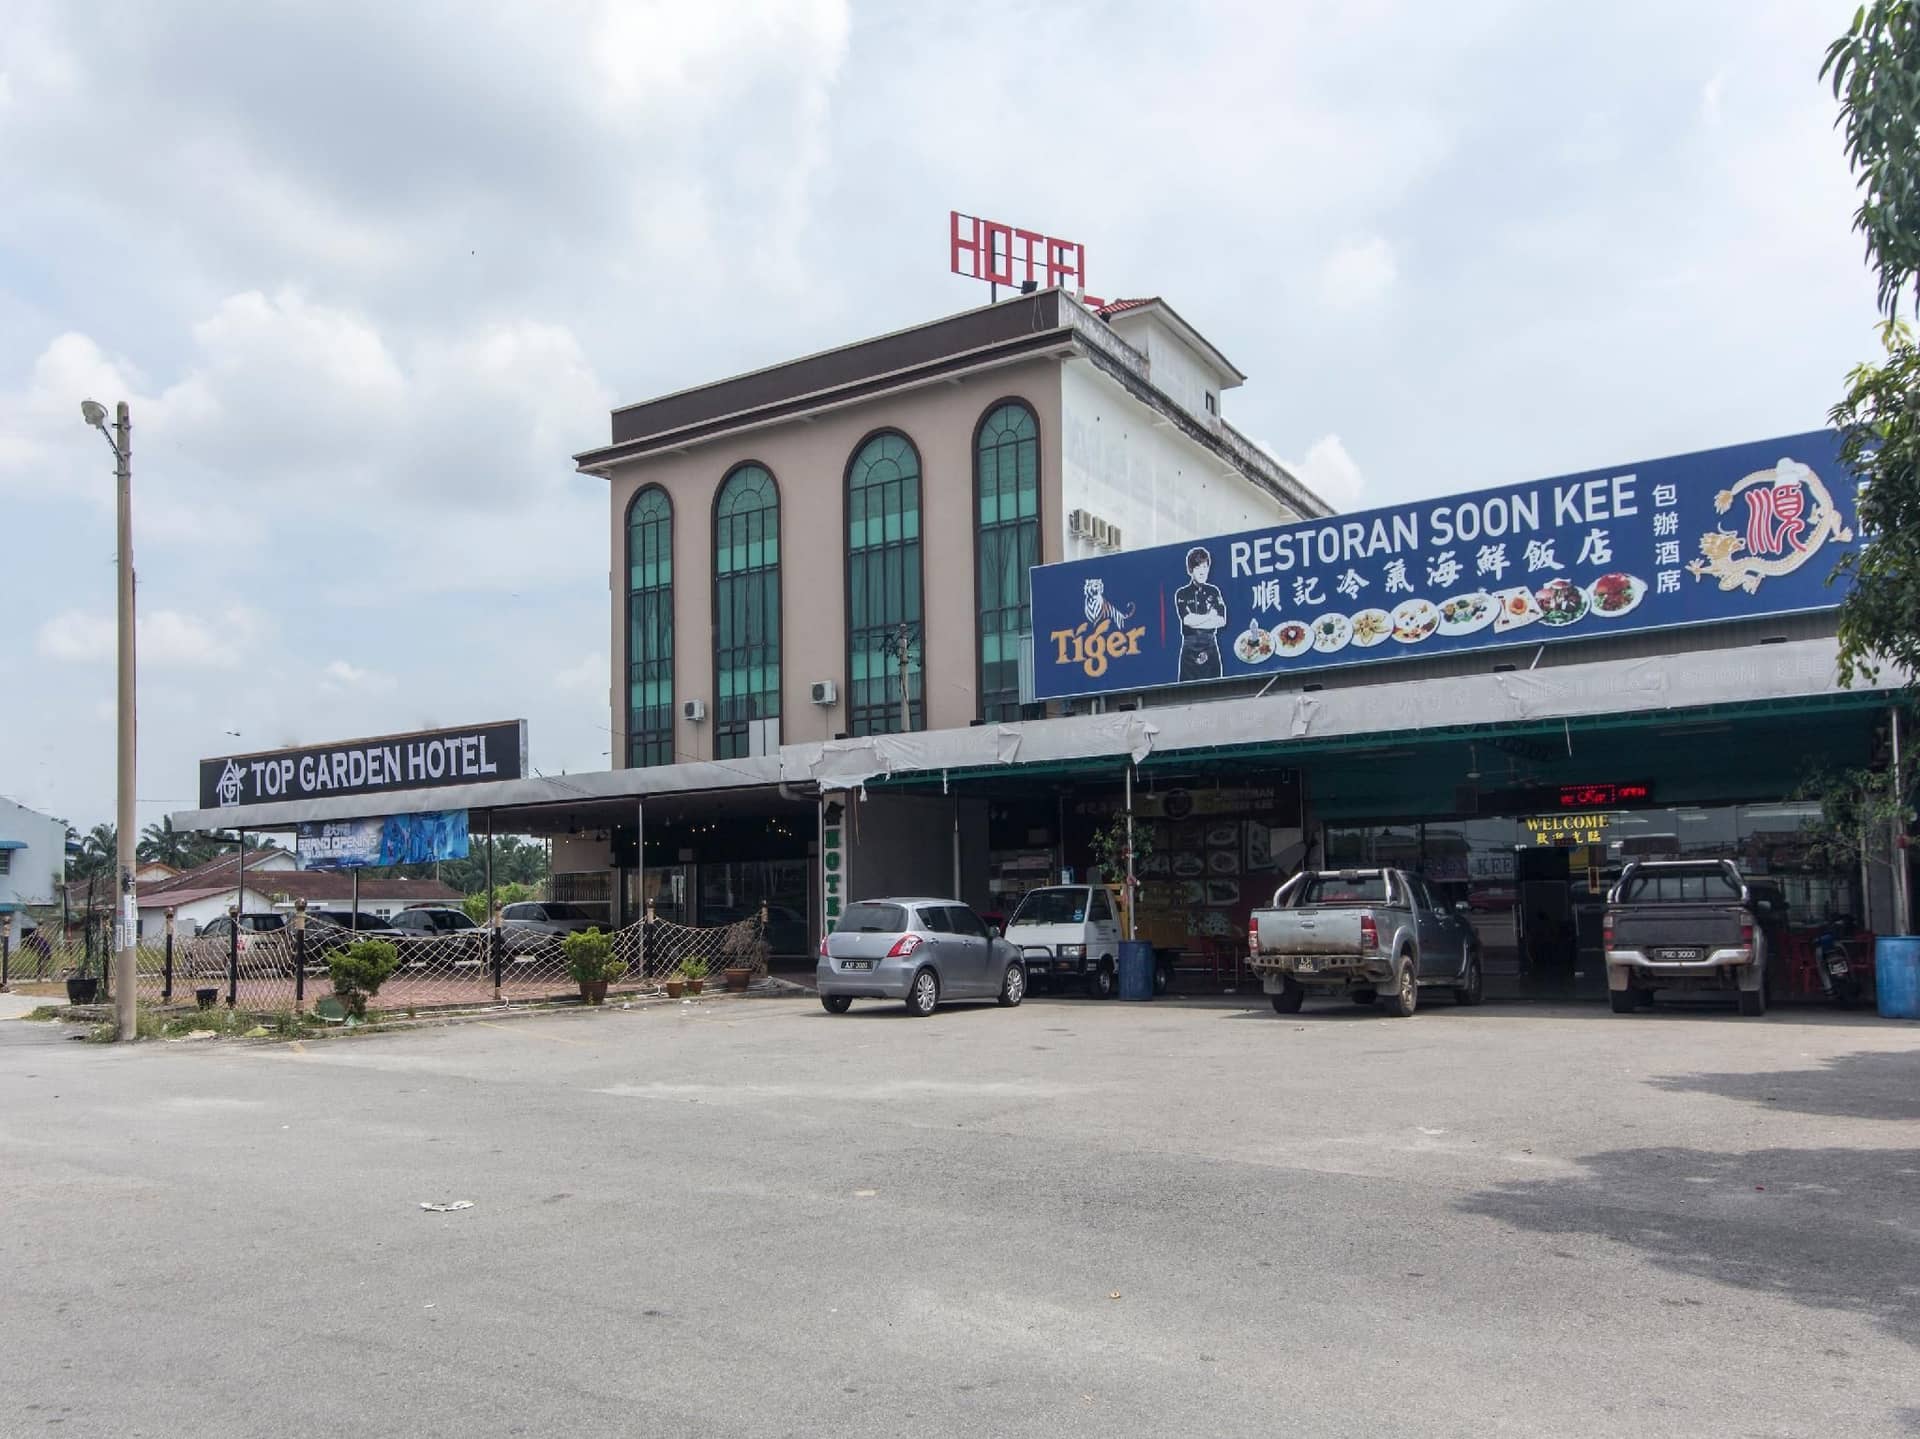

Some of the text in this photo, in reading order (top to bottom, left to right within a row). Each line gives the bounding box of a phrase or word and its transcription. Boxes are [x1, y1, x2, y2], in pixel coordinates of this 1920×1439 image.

[950, 210, 1105, 307] HOTEL
[1230, 473, 1639, 579] RESTORAN SOON KEE
[1651, 483, 1681, 594] 包辦酒席
[1050, 618, 1147, 679] Tiger
[250, 734, 497, 797] TOP GARDEN HOTEL
[297, 831, 378, 851] GRAND OPENING
[1526, 814, 1609, 831] WELCOME
